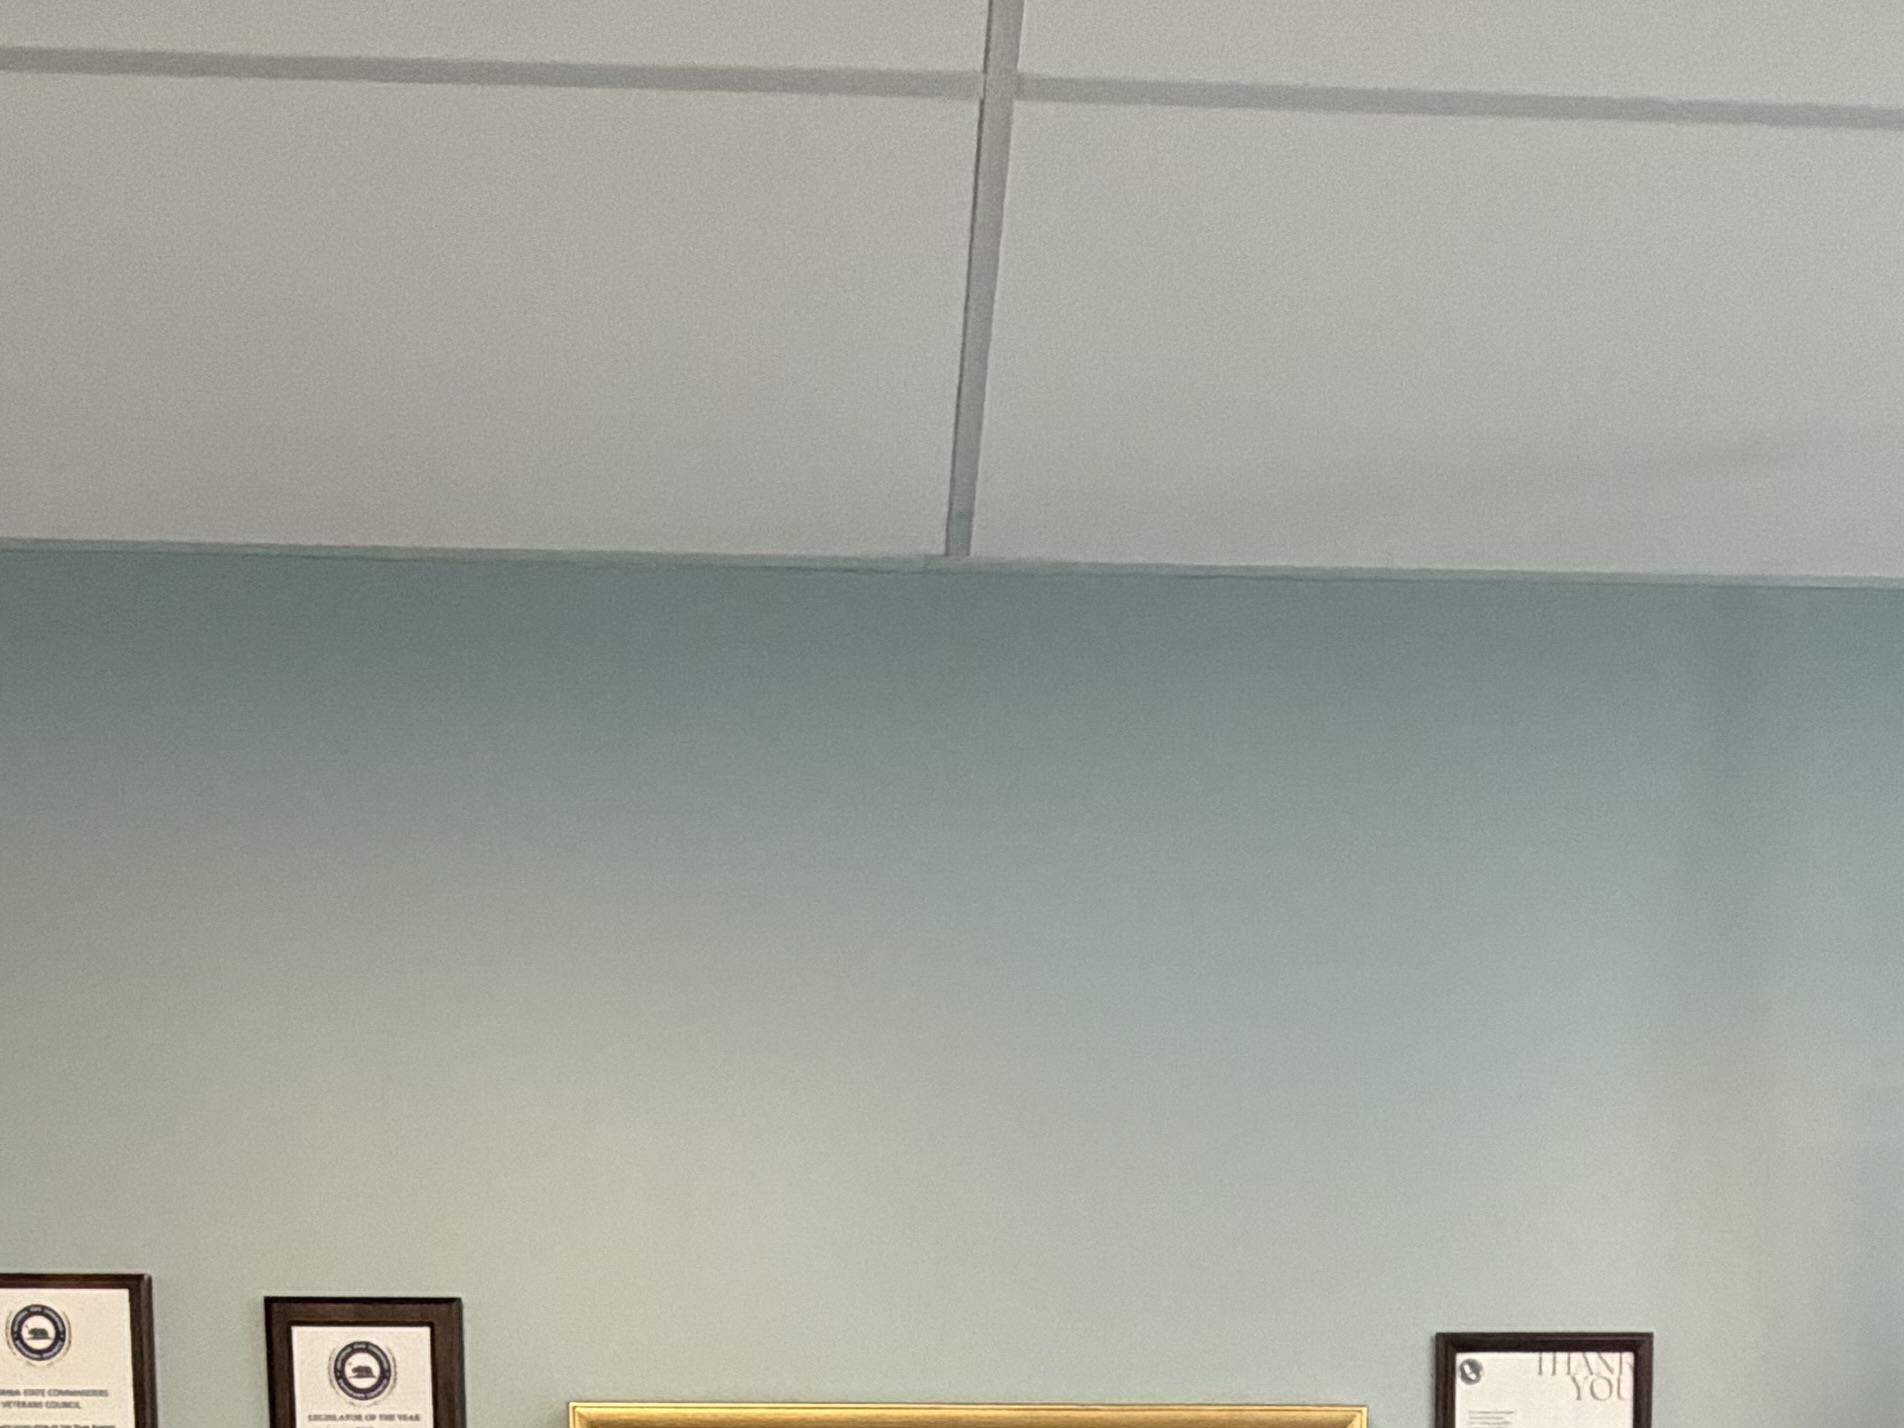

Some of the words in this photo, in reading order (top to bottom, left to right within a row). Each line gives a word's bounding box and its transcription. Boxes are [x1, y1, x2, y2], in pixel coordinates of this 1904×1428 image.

[24, 1389, 45, 1398] STATE
[1, 1401, 43, 1409] VETERANS
[45, 1401, 82, 1409] COUNCIL
